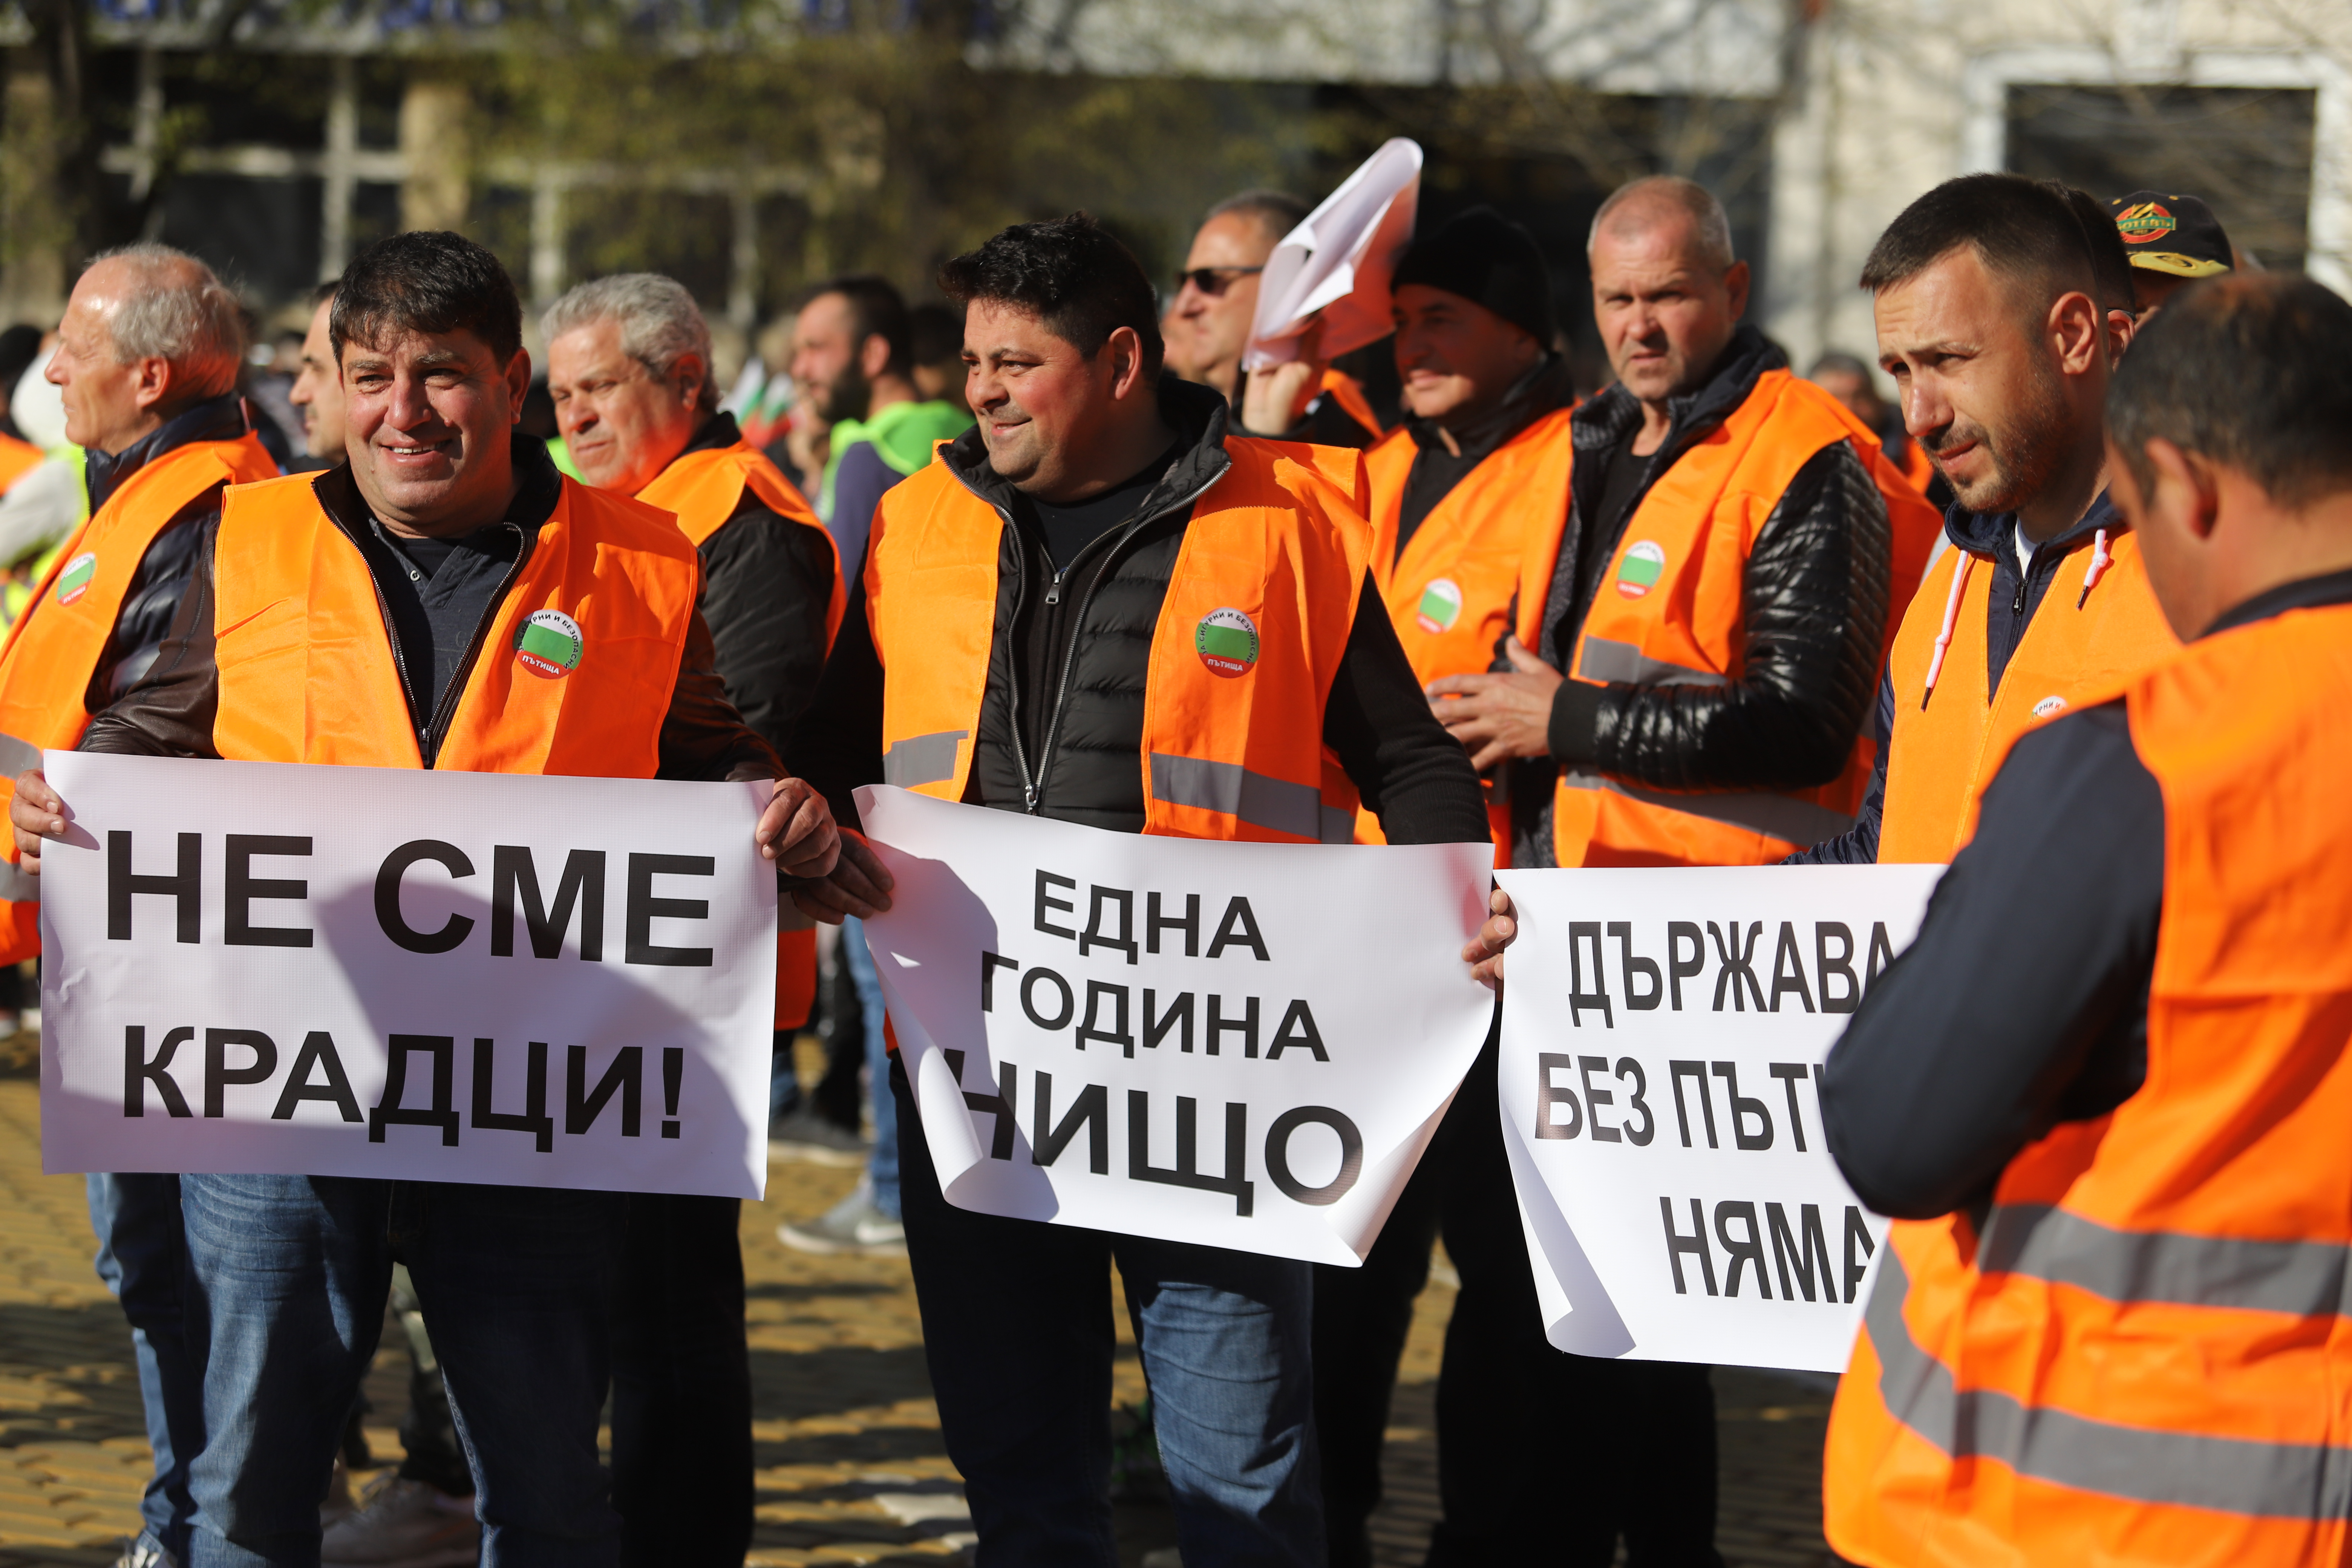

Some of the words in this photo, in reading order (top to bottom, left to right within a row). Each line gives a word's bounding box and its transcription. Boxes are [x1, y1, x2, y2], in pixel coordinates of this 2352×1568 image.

[522, 655, 559, 675] ПЪТИЩА
[562, 620, 579, 670] БЕЗОПАСНИ
[1199, 612, 1225, 642] СИГУРНИ
[1200, 645, 1208, 656] ЗА
[1207, 658, 1243, 671] ПЪТИЩА
[1236, 615, 1256, 664] БЕЗОПАСНИ
[108, 831, 313, 947] НЕ
[374, 840, 715, 966] СМЕ
[1035, 870, 1270, 965] ЕДНА
[982, 950, 1329, 1061] ГОДИНА
[124, 1026, 683, 1153] КРАДЦИ!
[944, 1048, 1363, 1216] НИЩО
[1535, 1053, 1654, 1146] БЕЗ
[1660, 1197, 1875, 1303] НЯМА
